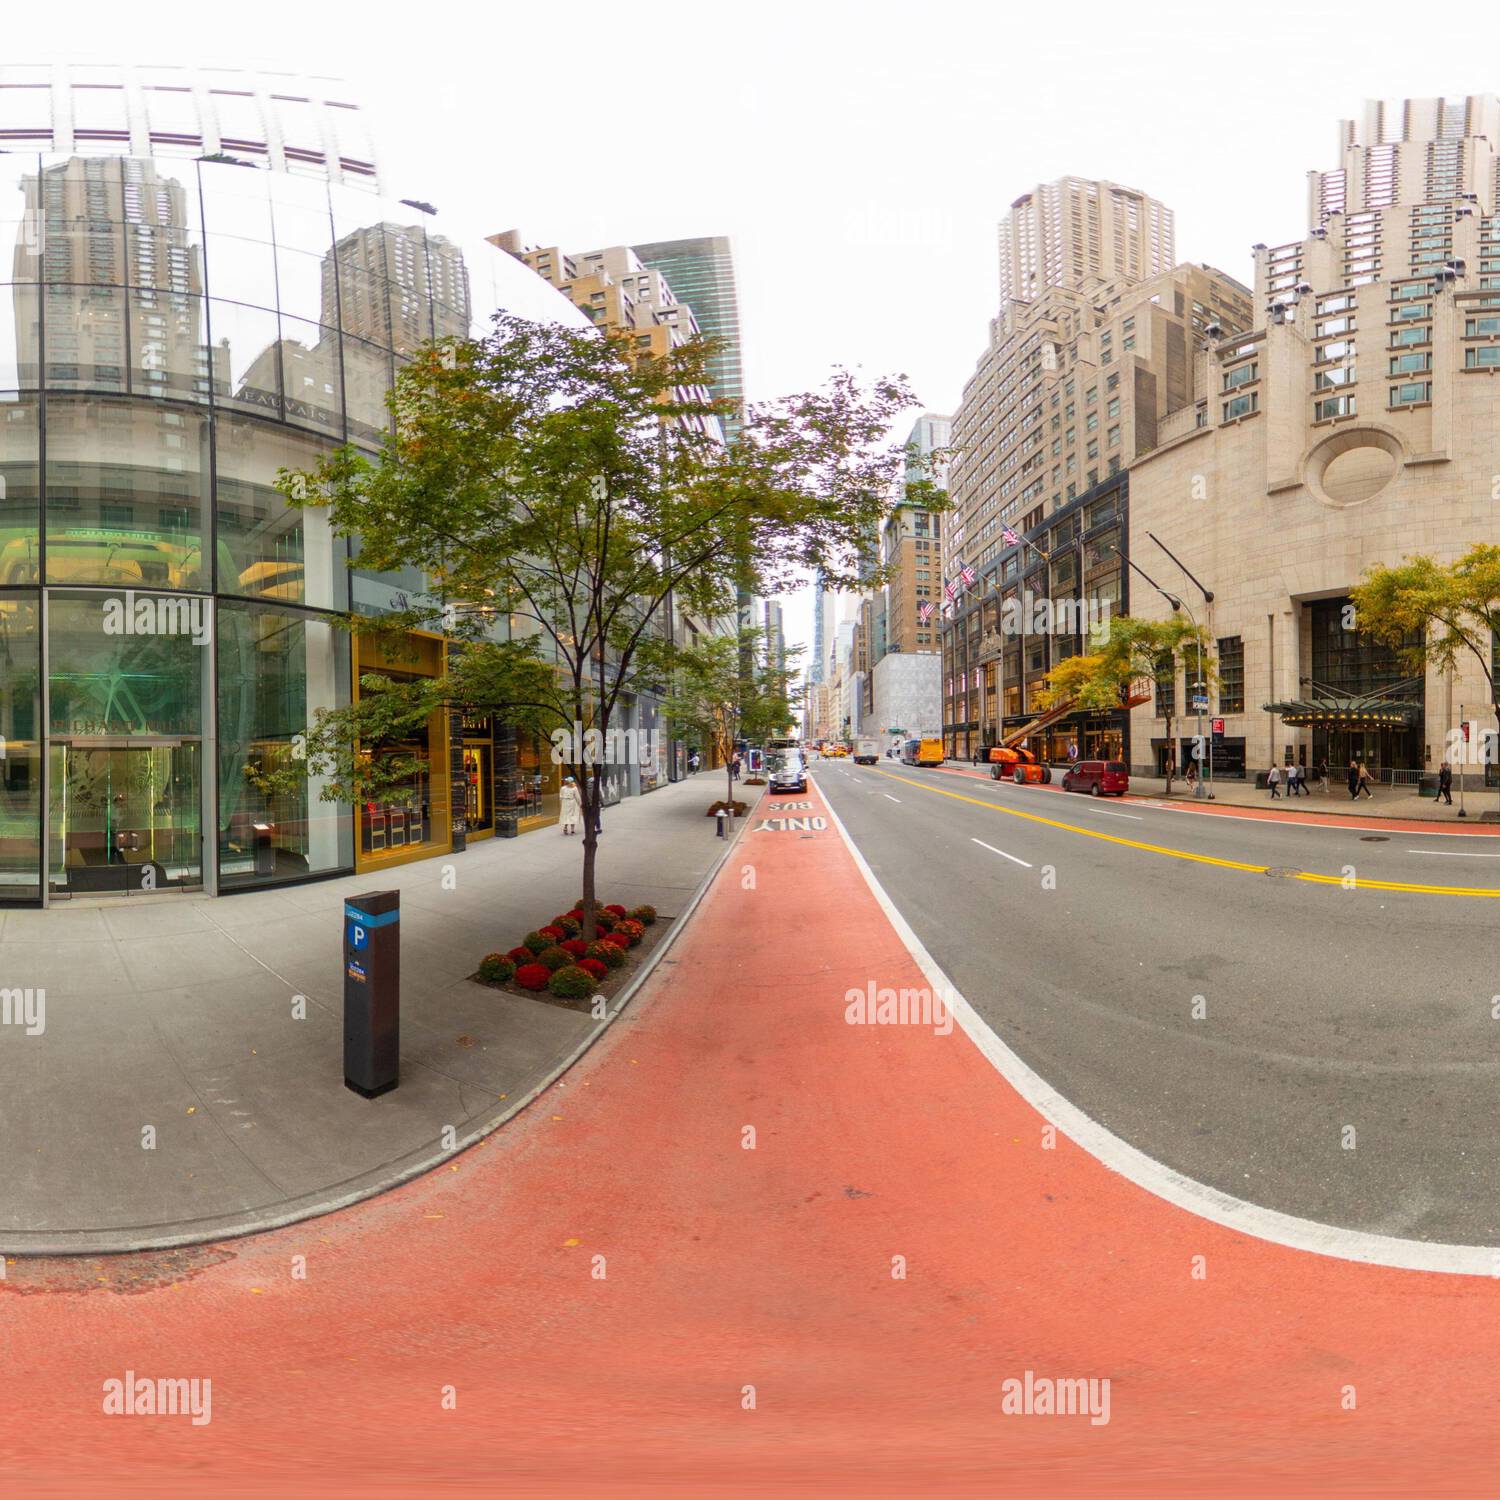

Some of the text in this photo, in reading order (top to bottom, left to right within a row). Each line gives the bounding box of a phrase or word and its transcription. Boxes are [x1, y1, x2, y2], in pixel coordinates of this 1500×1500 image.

[769, 801, 813, 811] BUS
[752, 816, 828, 832] ONLY
[354, 926, 364, 945] P
